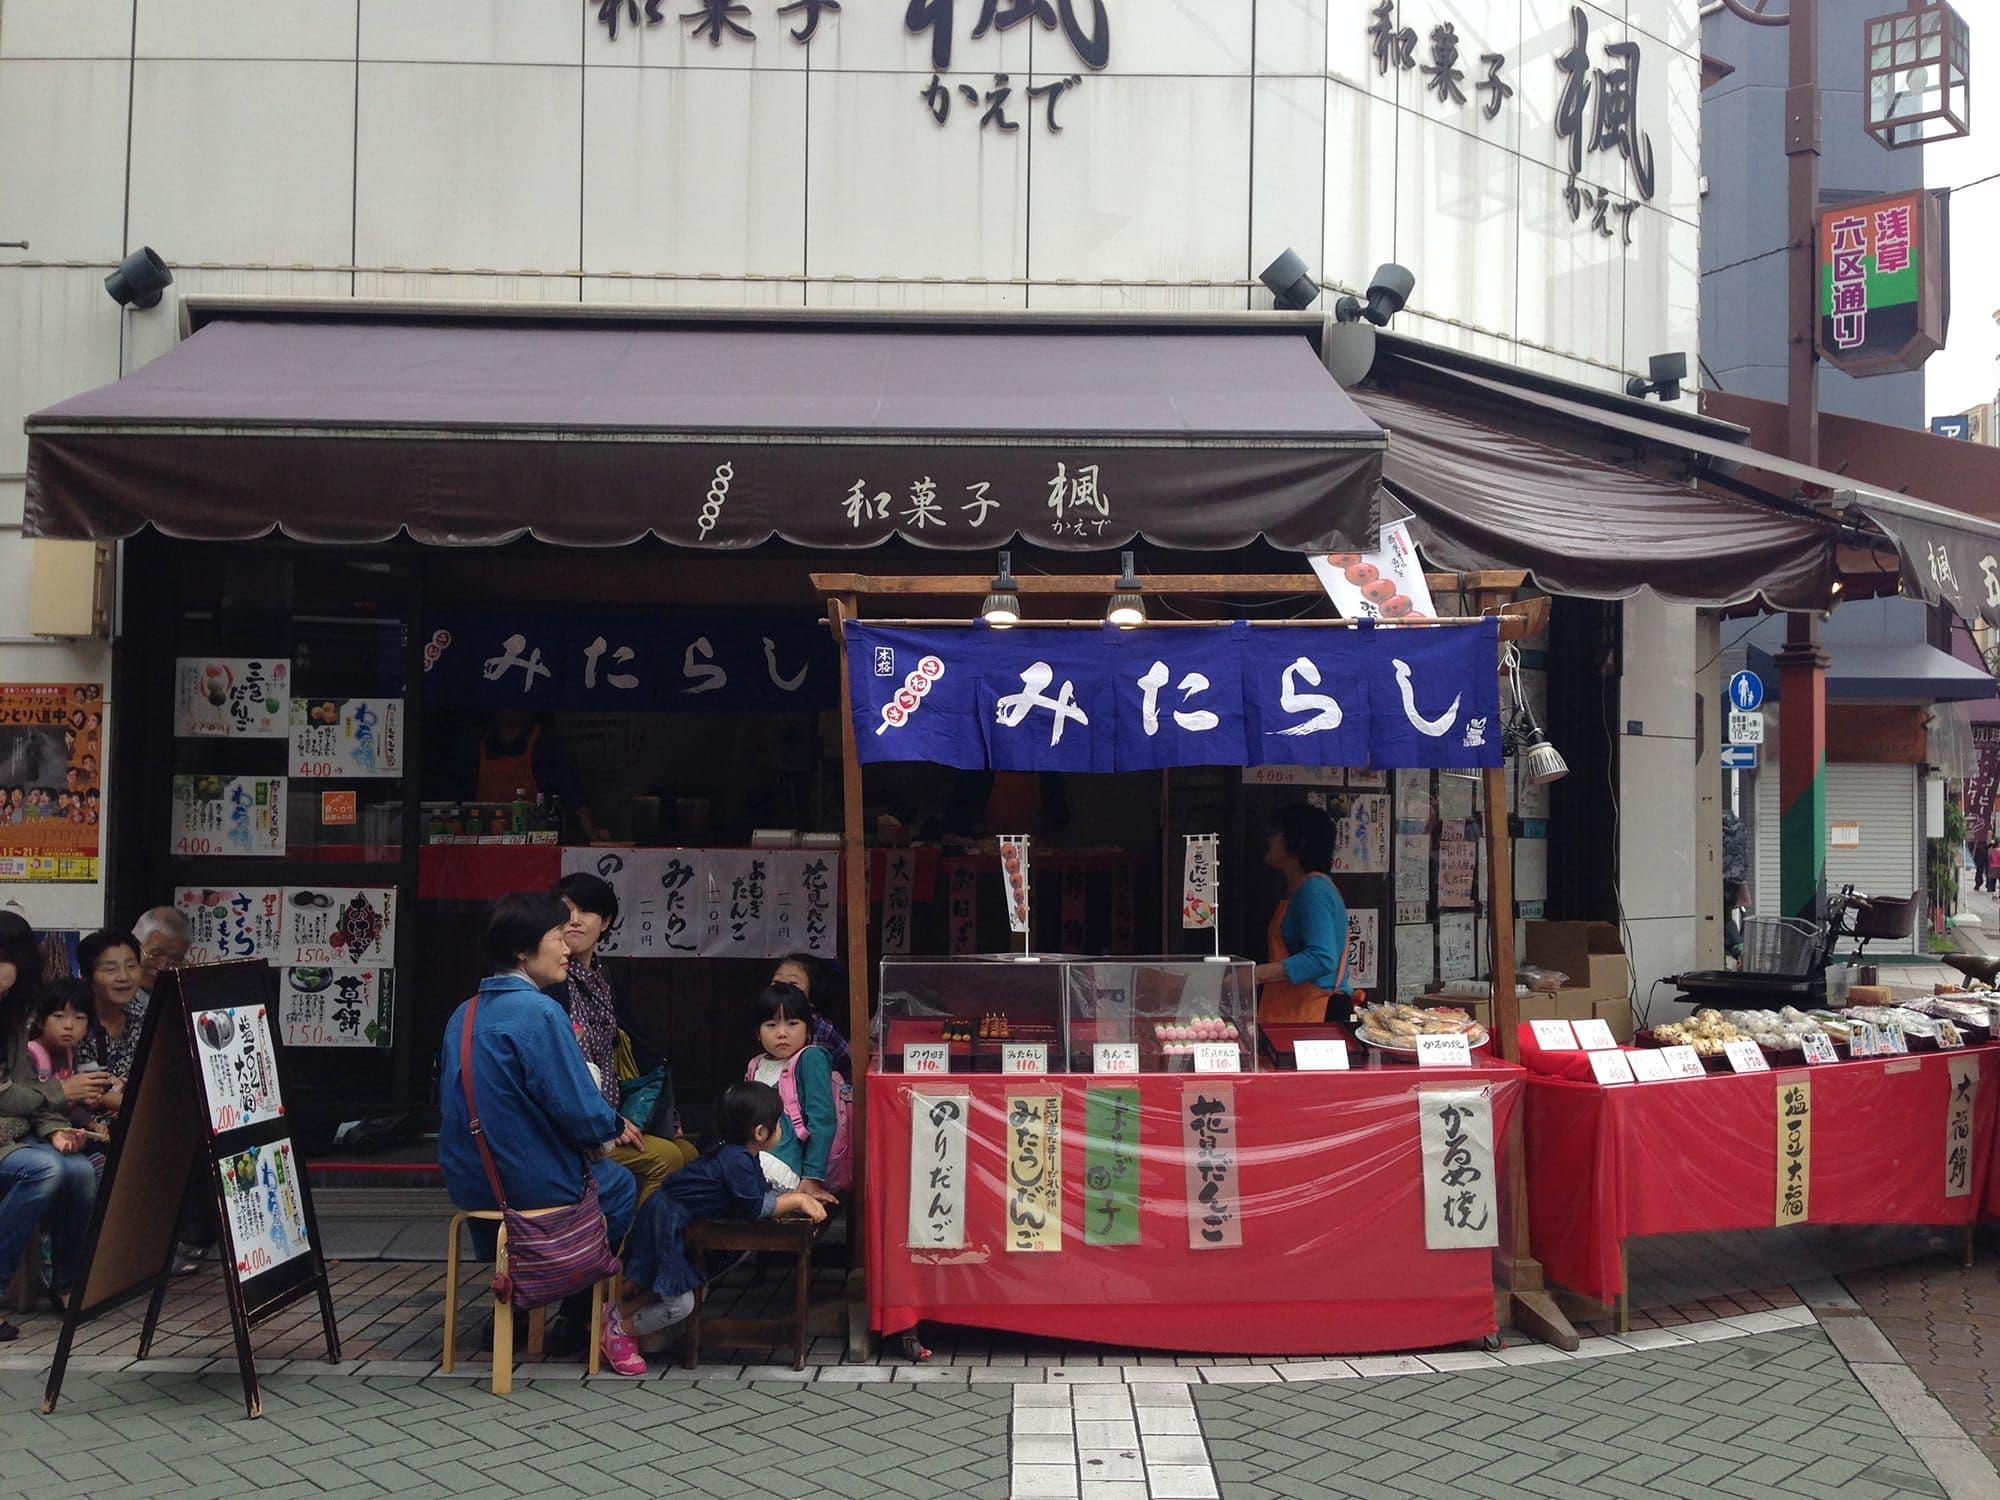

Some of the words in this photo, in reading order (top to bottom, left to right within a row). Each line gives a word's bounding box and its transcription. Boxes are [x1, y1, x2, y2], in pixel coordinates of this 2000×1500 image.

[921, 74, 1083, 134] かえで
[1555, 6, 1654, 201] 楓
[1562, 173, 1641, 246] かえで
[1874, 205, 1911, 274] 浅草
[1831, 216, 1867, 349] 六区通り
[841, 476, 1000, 527] 和菓子
[1047, 461, 1110, 520] 楓
[1052, 519, 1112, 536] かえで
[482, 633, 809, 693] みたらし
[876, 649, 892, 674] 本格
[229, 684, 255, 732] だんご
[996, 656, 1462, 747] みたらし
[661, 858, 698, 951] みたらし
[730, 876, 749, 941] だんご
[749, 859, 768, 919] よもぎ
[802, 858, 830, 951] 花見だんご
[217, 919, 231, 957] もち
[231, 892, 255, 956] さくら
[331, 975, 364, 1037] 草餅
[1007, 1049, 1042, 1060] みたらし
[1783, 1086, 1808, 1217] 塩豆大福
[1948, 1073, 1973, 1188] 大福餅
[928, 1100, 961, 1242] のりだんご
[1008, 1099, 1047, 1249] みたらしだんご
[1190, 1094, 1234, 1243] 花見だんご
[1438, 1103, 1489, 1231] かるめ焼
